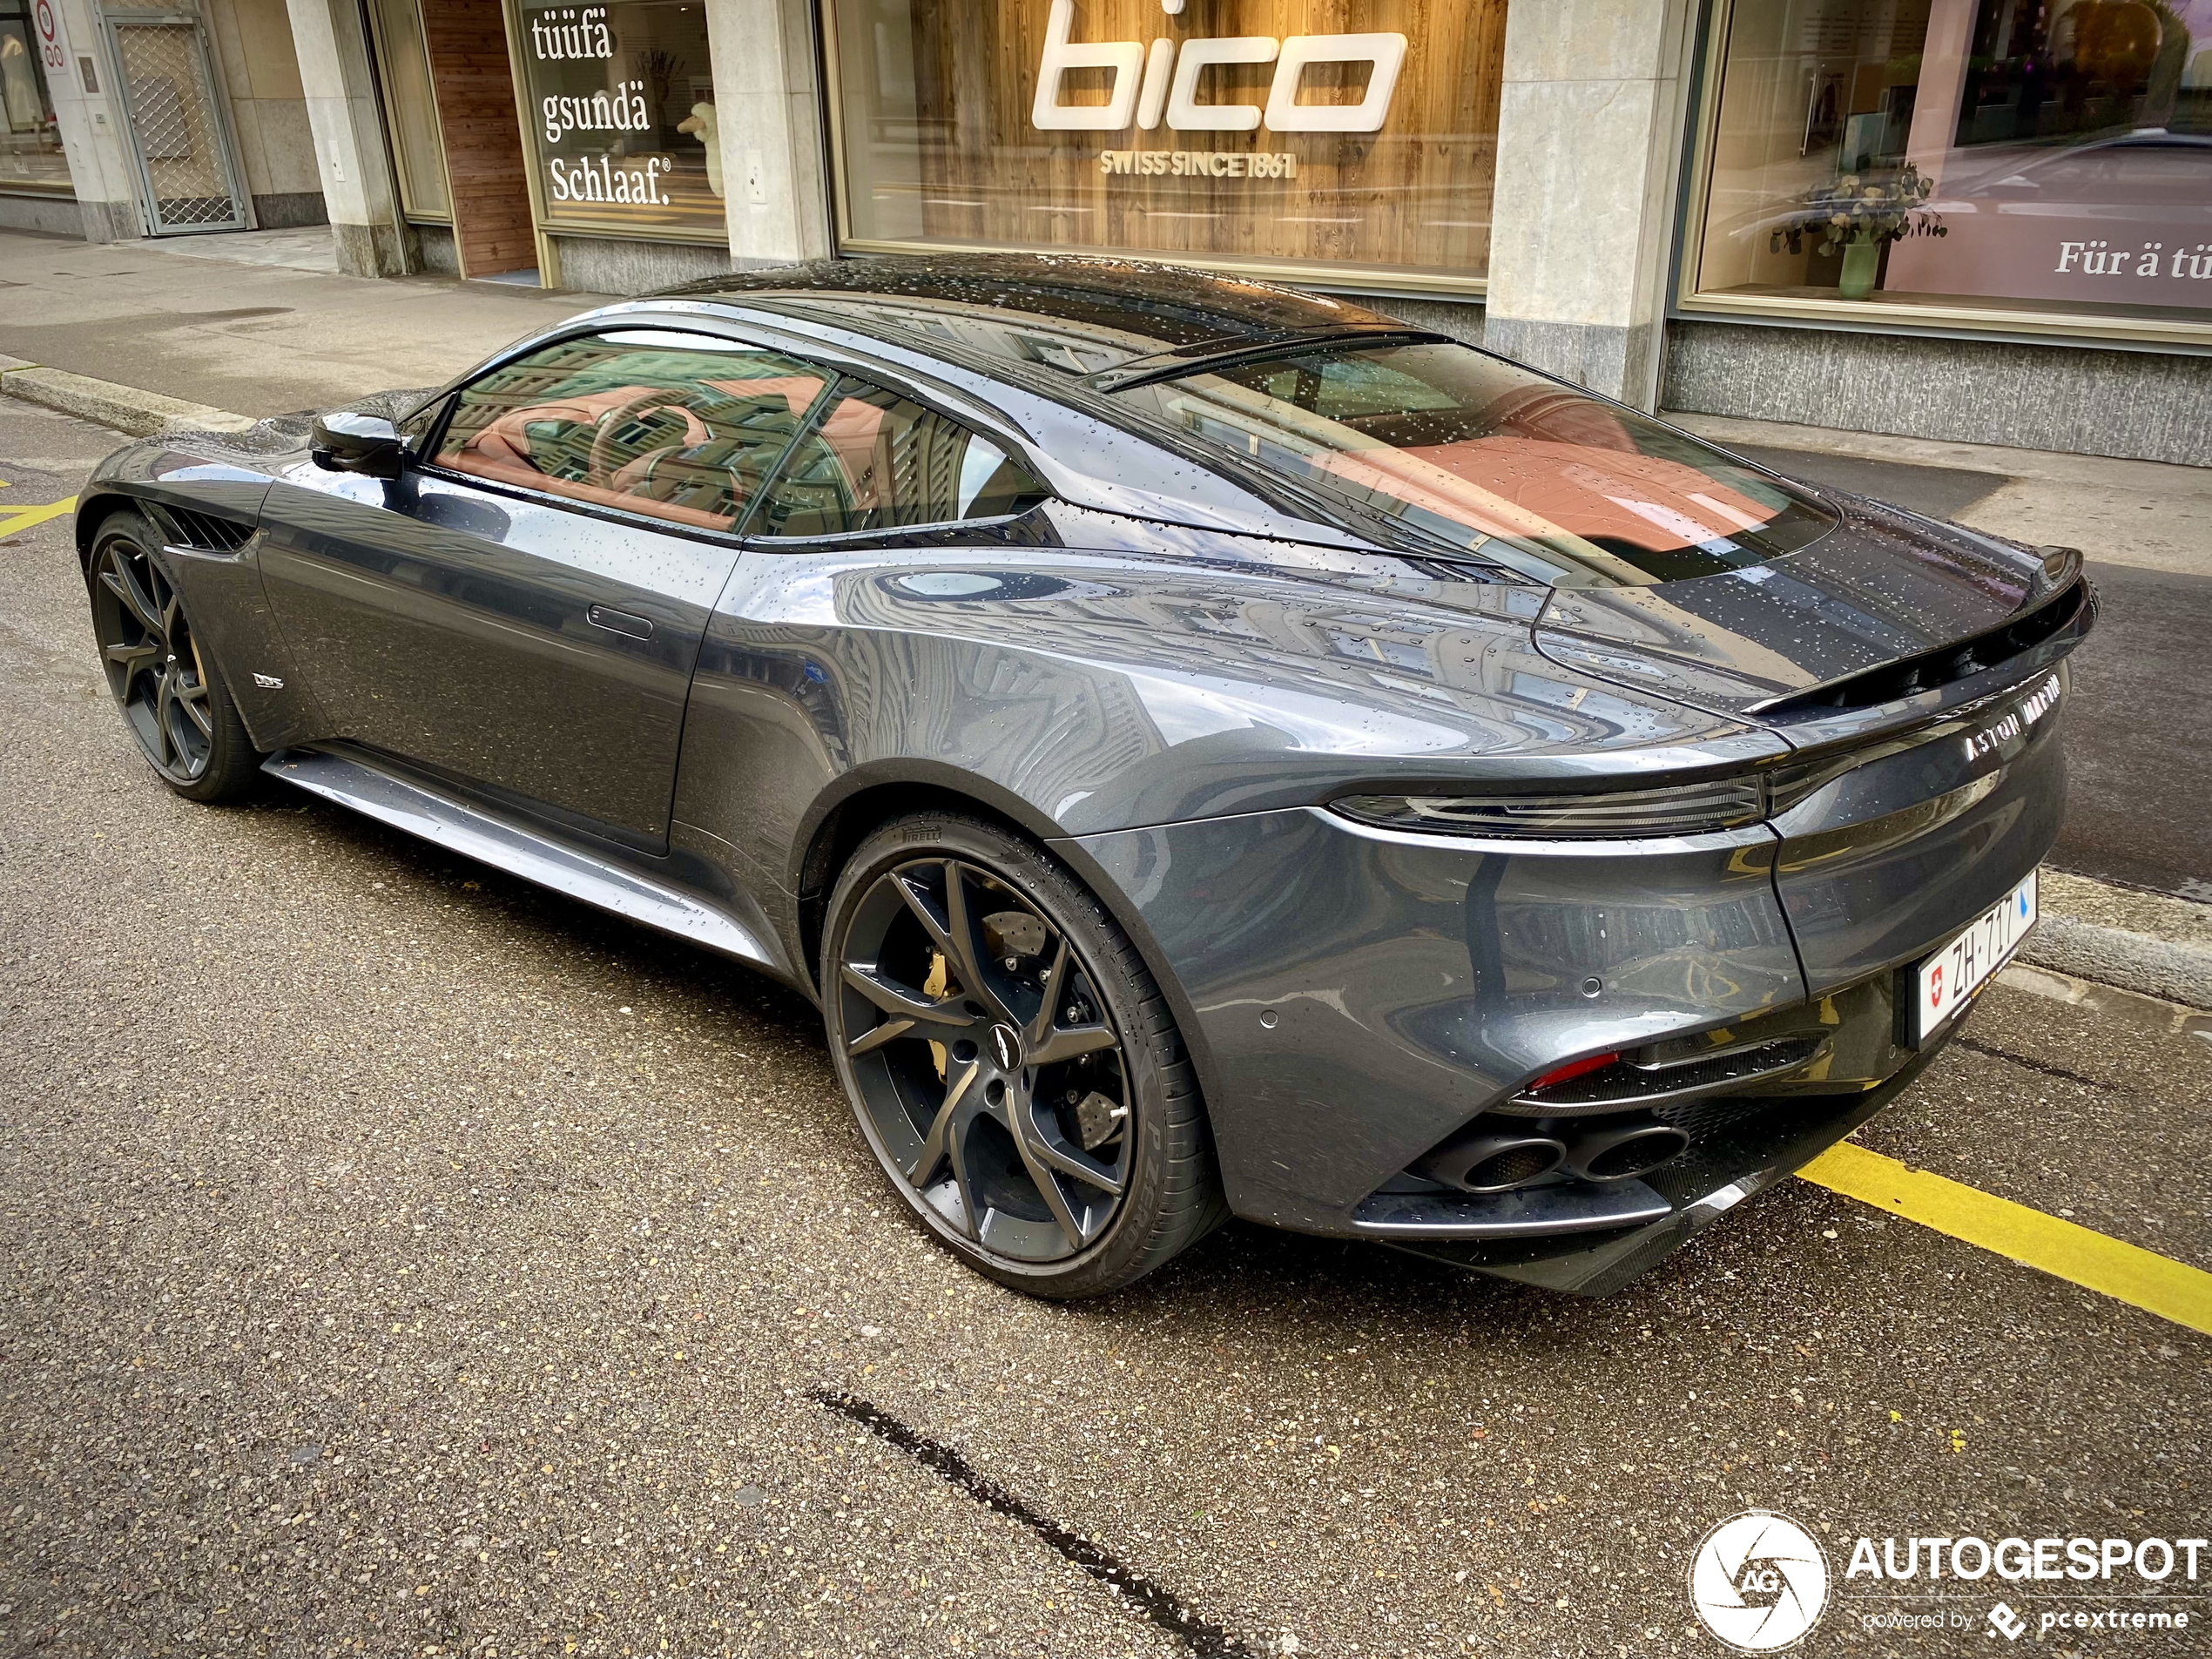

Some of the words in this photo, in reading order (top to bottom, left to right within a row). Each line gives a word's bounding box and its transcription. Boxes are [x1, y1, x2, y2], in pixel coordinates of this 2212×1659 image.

[532, 7, 613, 60] tüüfä
[1032, 0, 1409, 132] bico
[543, 79, 651, 144] gsundä
[1100, 150, 1171, 176] SWISS
[1171, 151, 1245, 178] SINCE
[1245, 152, 1297, 179] 1861
[2054, 240, 2131, 275] Für
[2136, 242, 2162, 277] ä
[252, 672, 284, 689] DBS
[1966, 712, 2020, 762] ASTON
